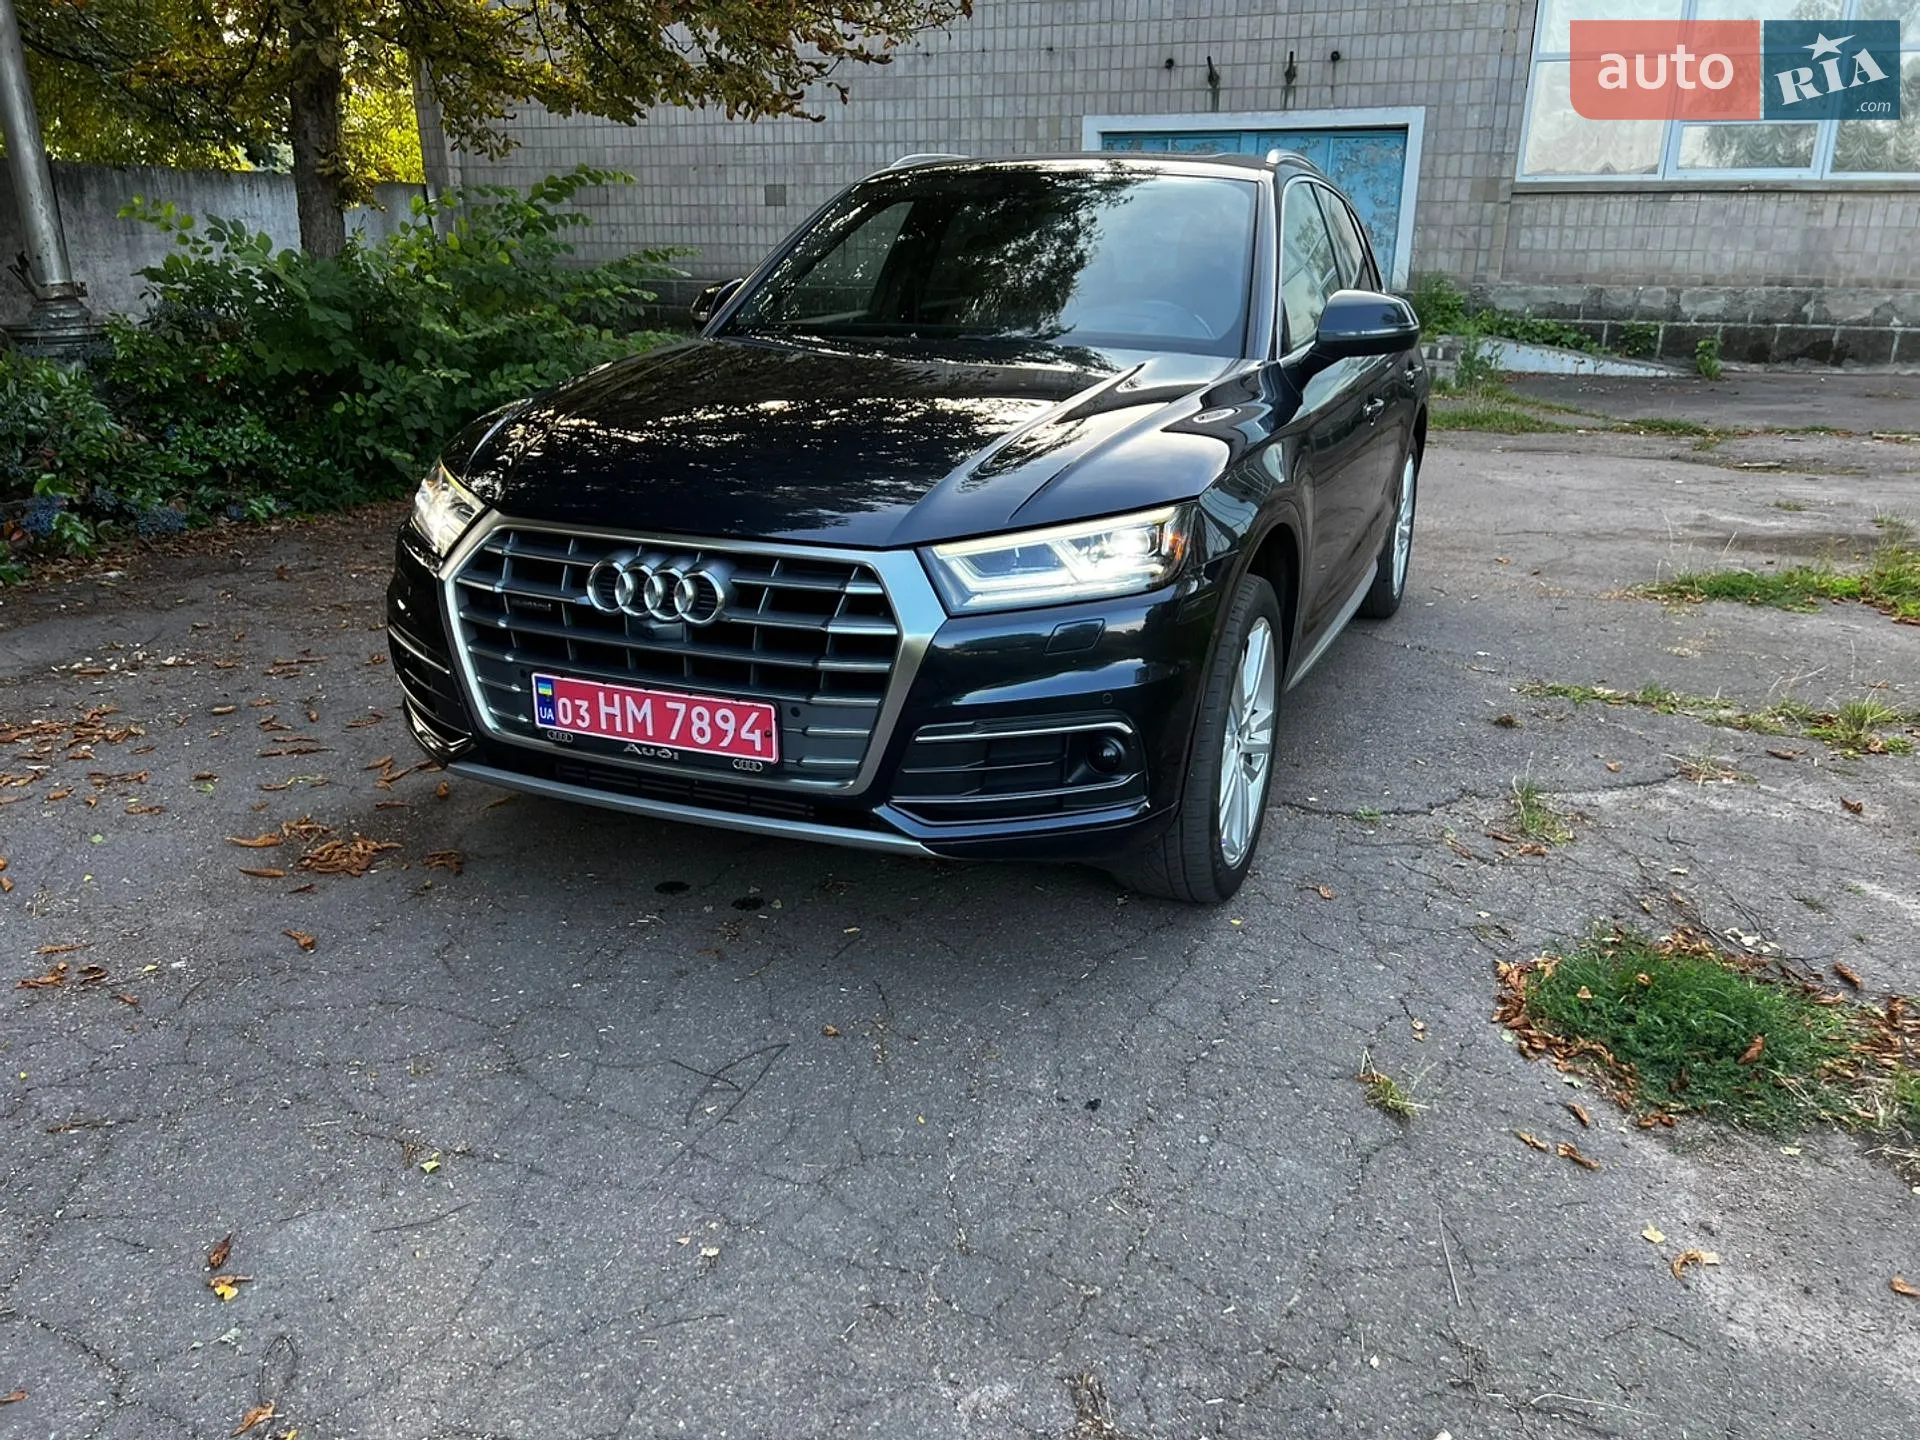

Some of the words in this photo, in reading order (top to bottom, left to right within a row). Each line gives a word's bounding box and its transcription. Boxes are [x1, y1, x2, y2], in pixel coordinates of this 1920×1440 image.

[539, 706, 555, 721] UA
[557, 697, 591, 728] 03
[598, 691, 654, 737] HM
[666, 701, 762, 751] 7894
